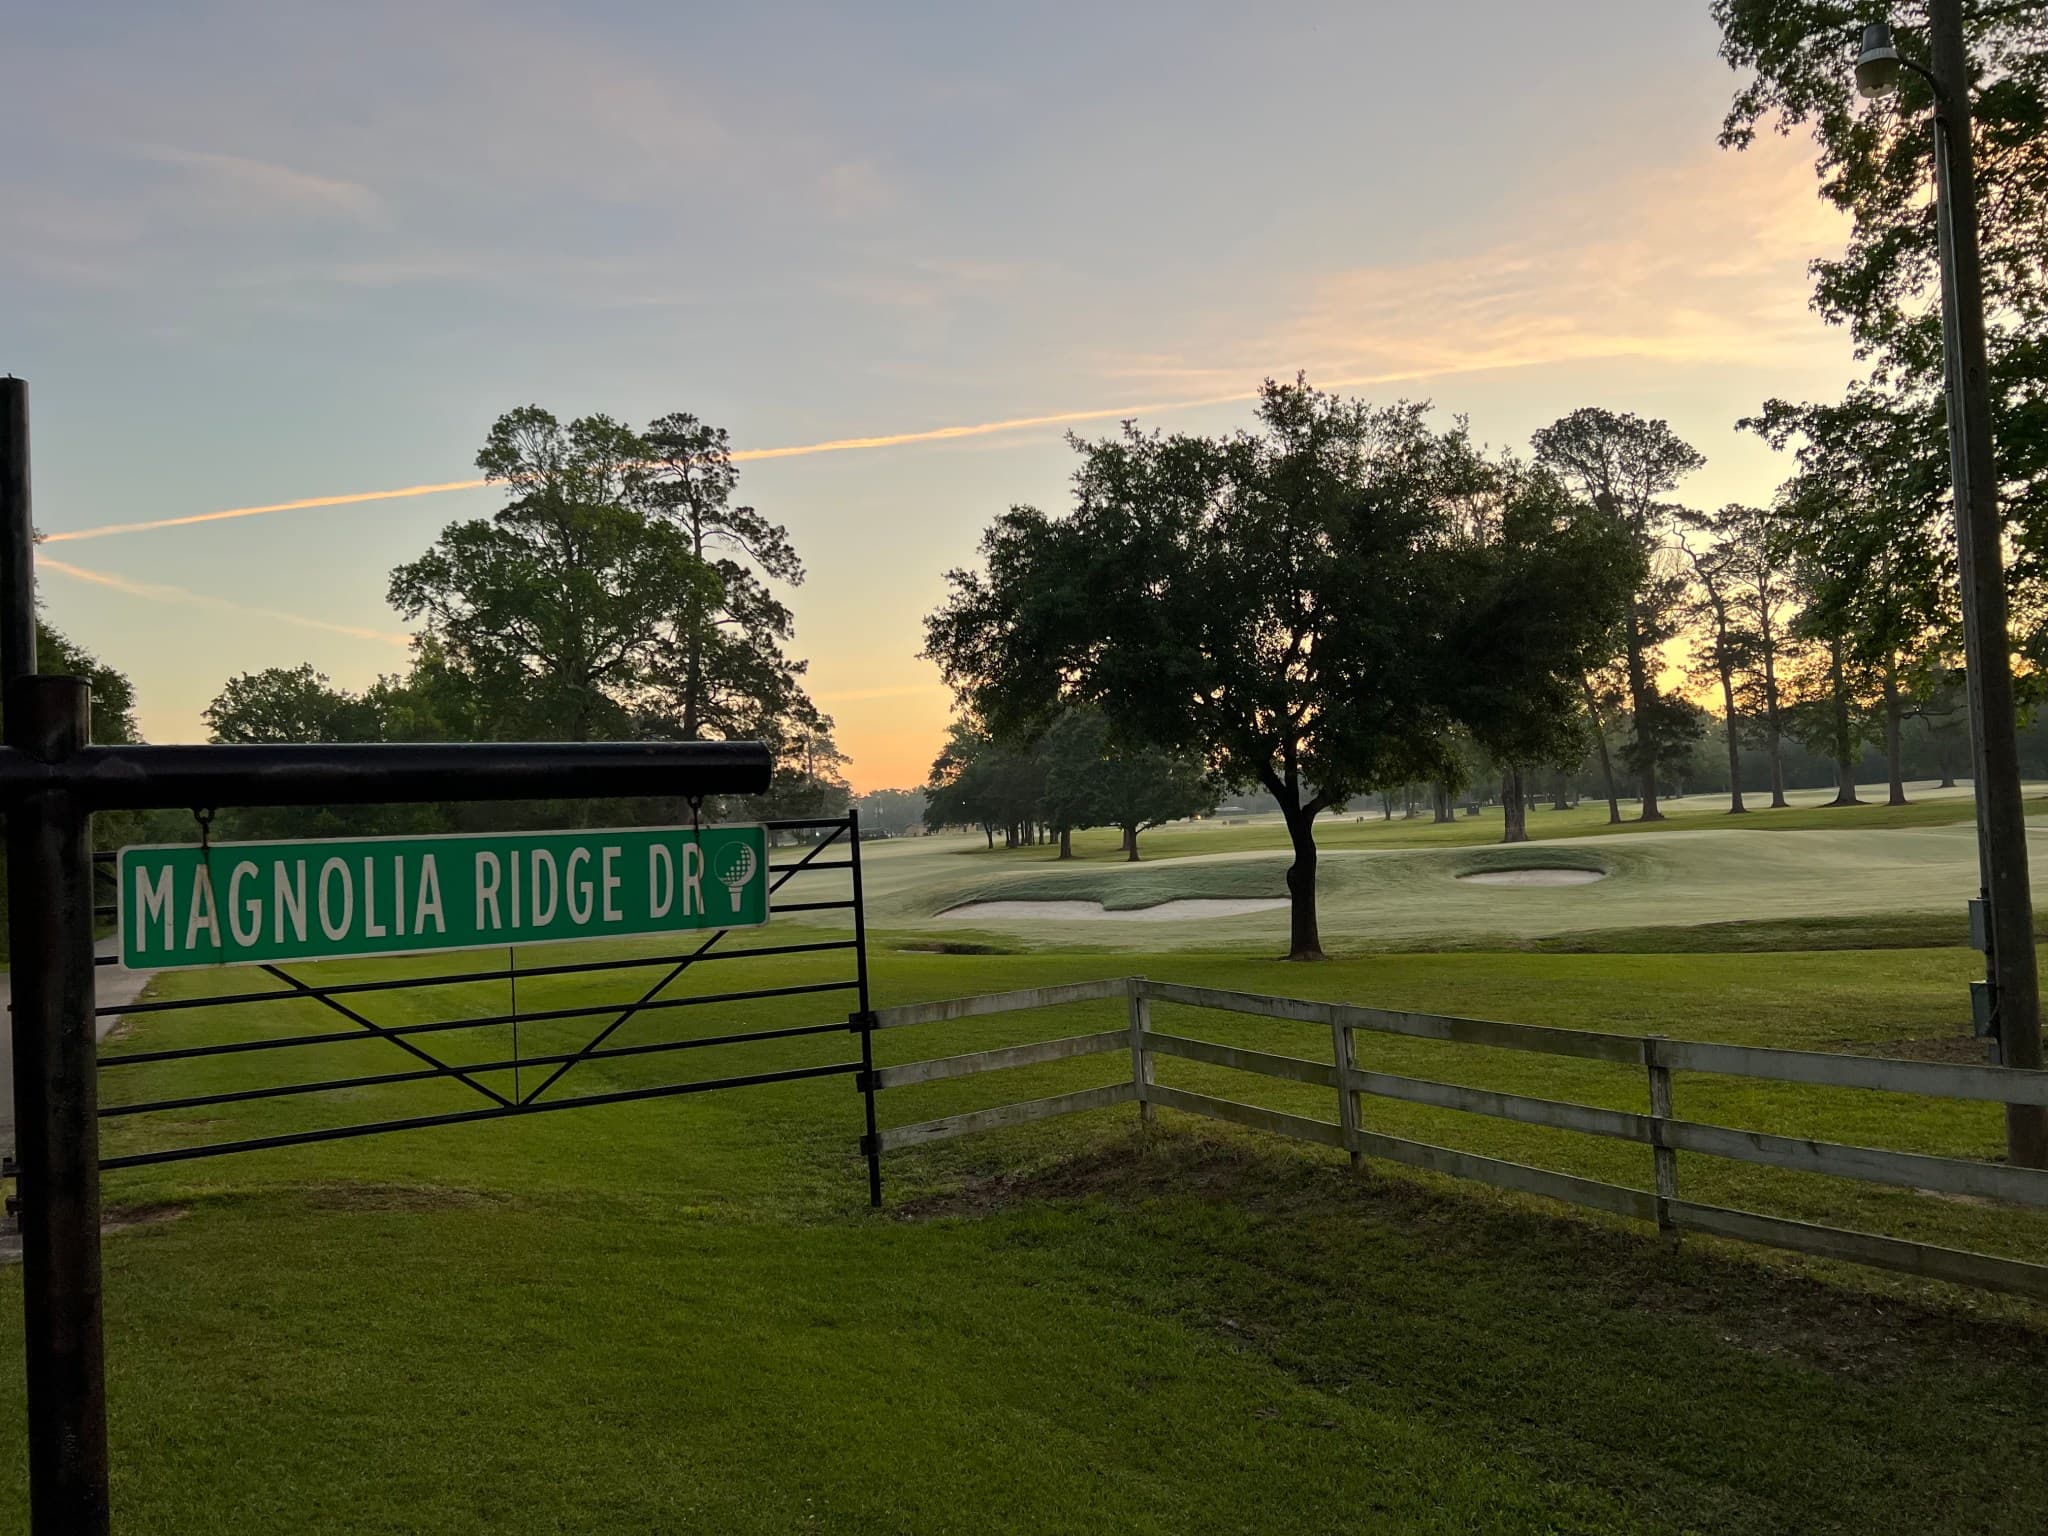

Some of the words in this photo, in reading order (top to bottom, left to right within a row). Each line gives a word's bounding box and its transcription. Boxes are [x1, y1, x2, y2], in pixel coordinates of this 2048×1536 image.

[136, 854, 446, 952] MAGNOLIA
[475, 847, 623, 930] RIDGE
[650, 842, 705, 919] DR
